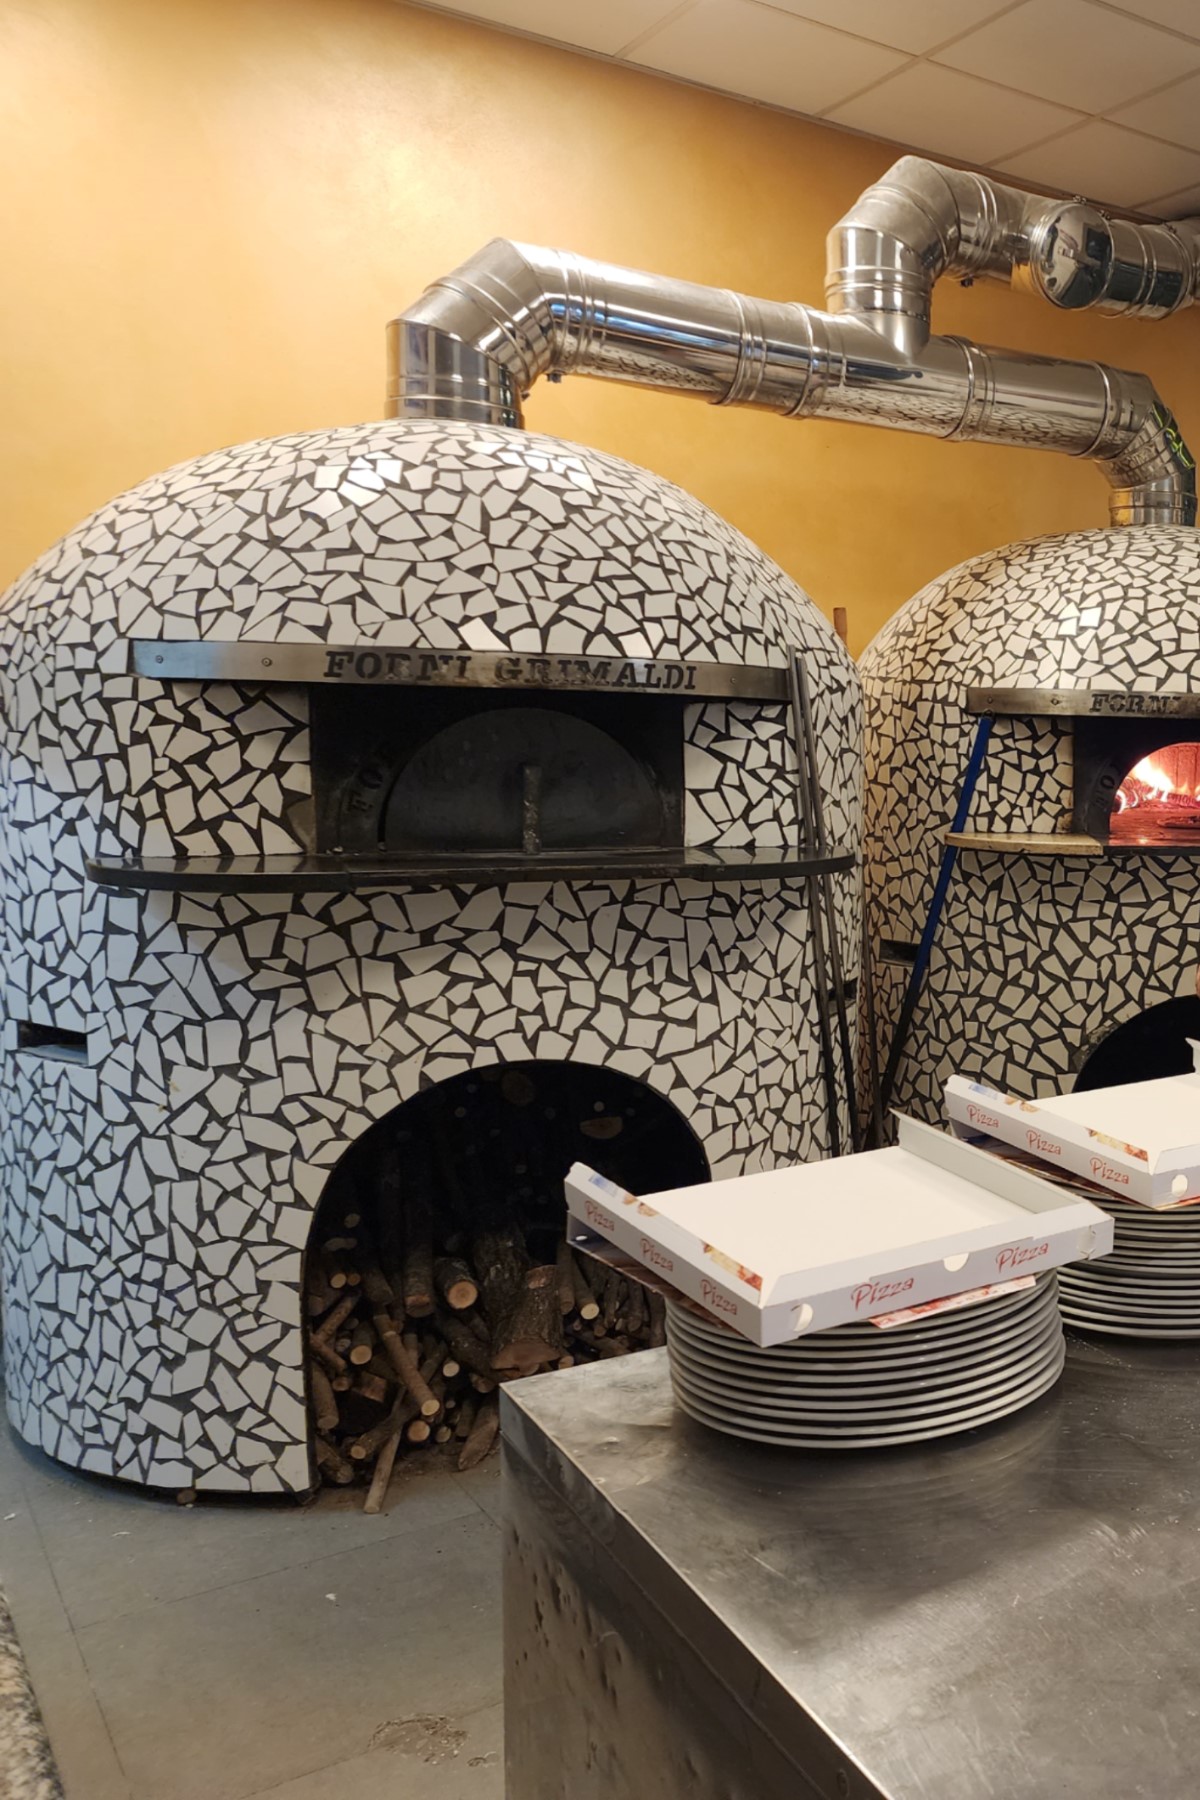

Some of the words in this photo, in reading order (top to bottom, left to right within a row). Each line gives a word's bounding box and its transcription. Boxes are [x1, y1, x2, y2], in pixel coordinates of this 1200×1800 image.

[323, 650, 471, 683] FORNI
[494, 656, 698, 691] GRIMALDI
[1089, 693, 1183, 716] FORNI
[966, 1103, 1000, 1129] Pizza
[1026, 1129, 1062, 1156] Pizza
[1089, 1156, 1130, 1185] Pizza
[584, 1200, 615, 1232] Pizza
[639, 1238, 674, 1272] Pizza
[995, 1242, 1049, 1274] Pizza
[701, 1279, 738, 1316] Pizza
[851, 1277, 915, 1312] Pizza
